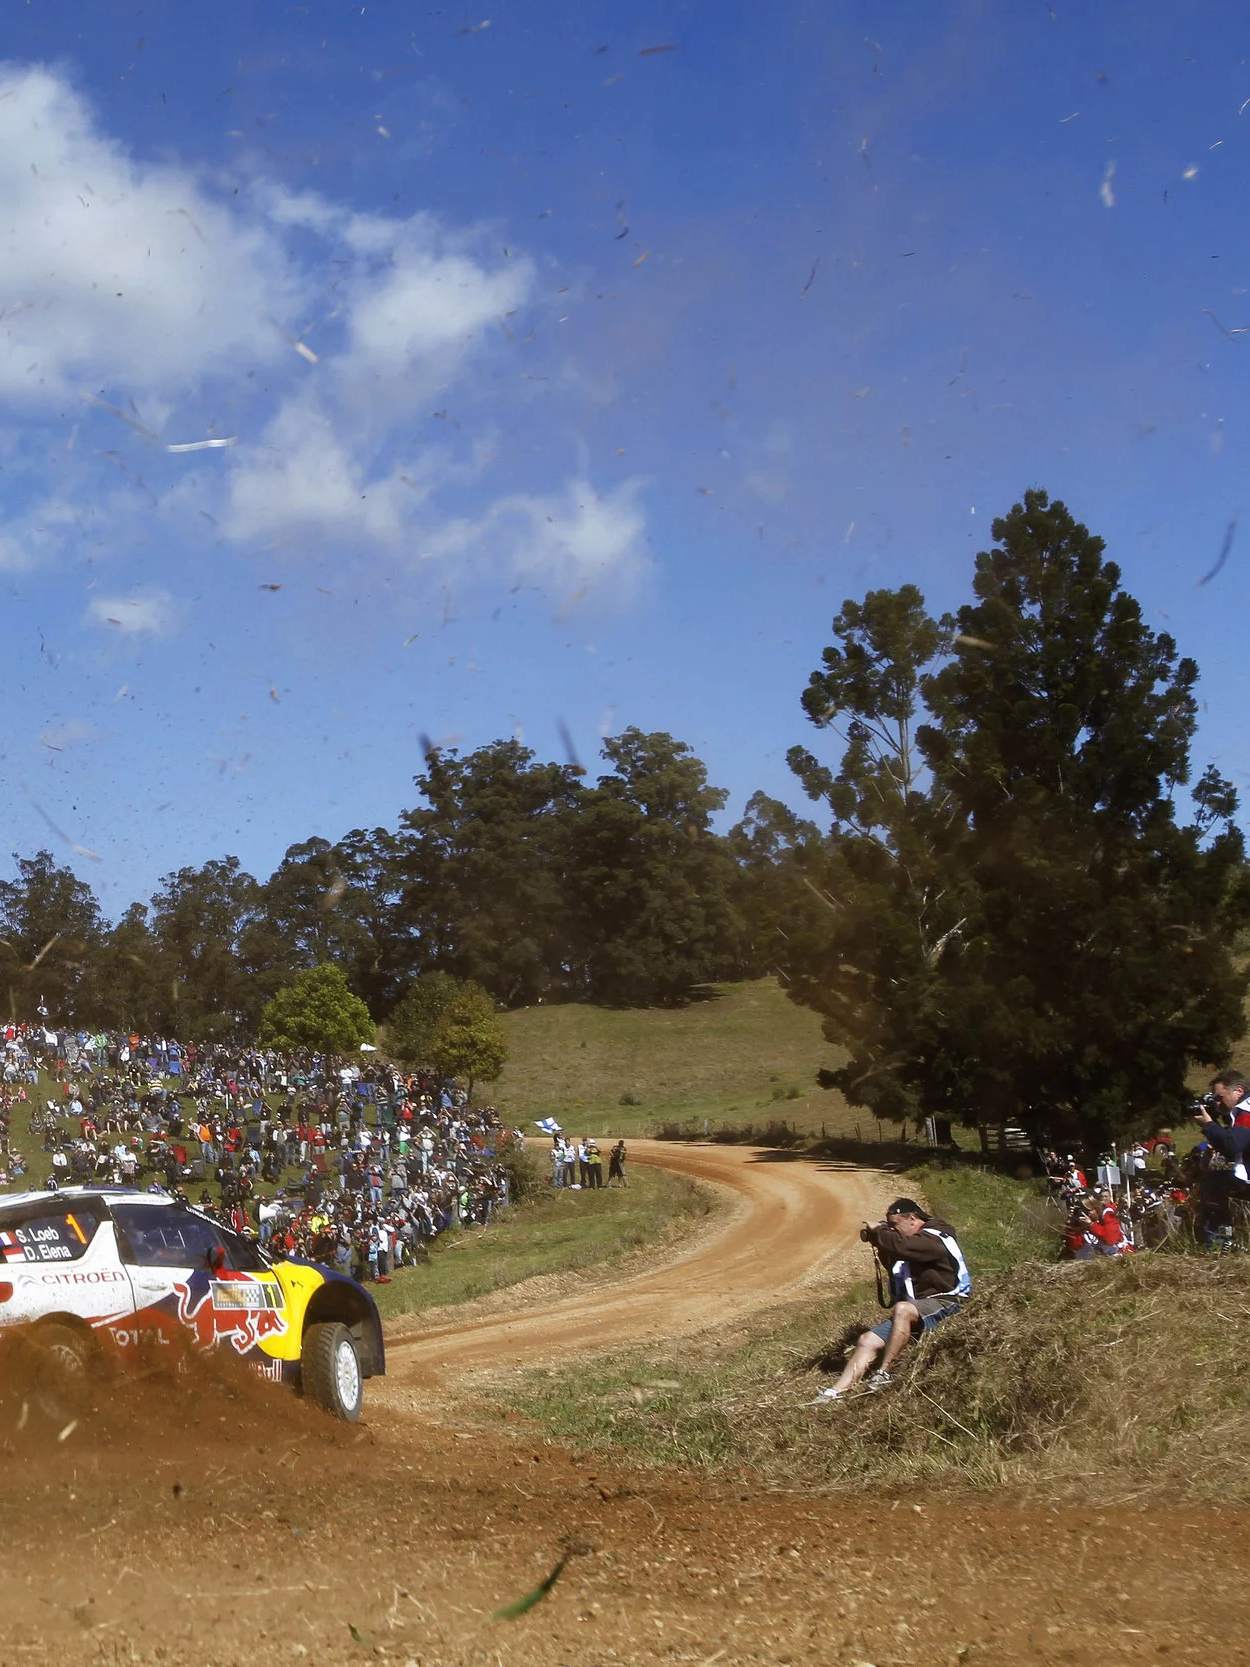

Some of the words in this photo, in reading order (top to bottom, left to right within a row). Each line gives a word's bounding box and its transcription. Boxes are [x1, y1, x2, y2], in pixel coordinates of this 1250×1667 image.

[15, 1229, 31, 1243] S.
[29, 1226, 59, 1242] Loeb
[65, 1213, 87, 1244] 1
[24, 1245, 40, 1261] D.
[39, 1245, 72, 1260] Elena
[42, 1268, 125, 1285] CITROËN
[266, 1284, 277, 1308] 1
